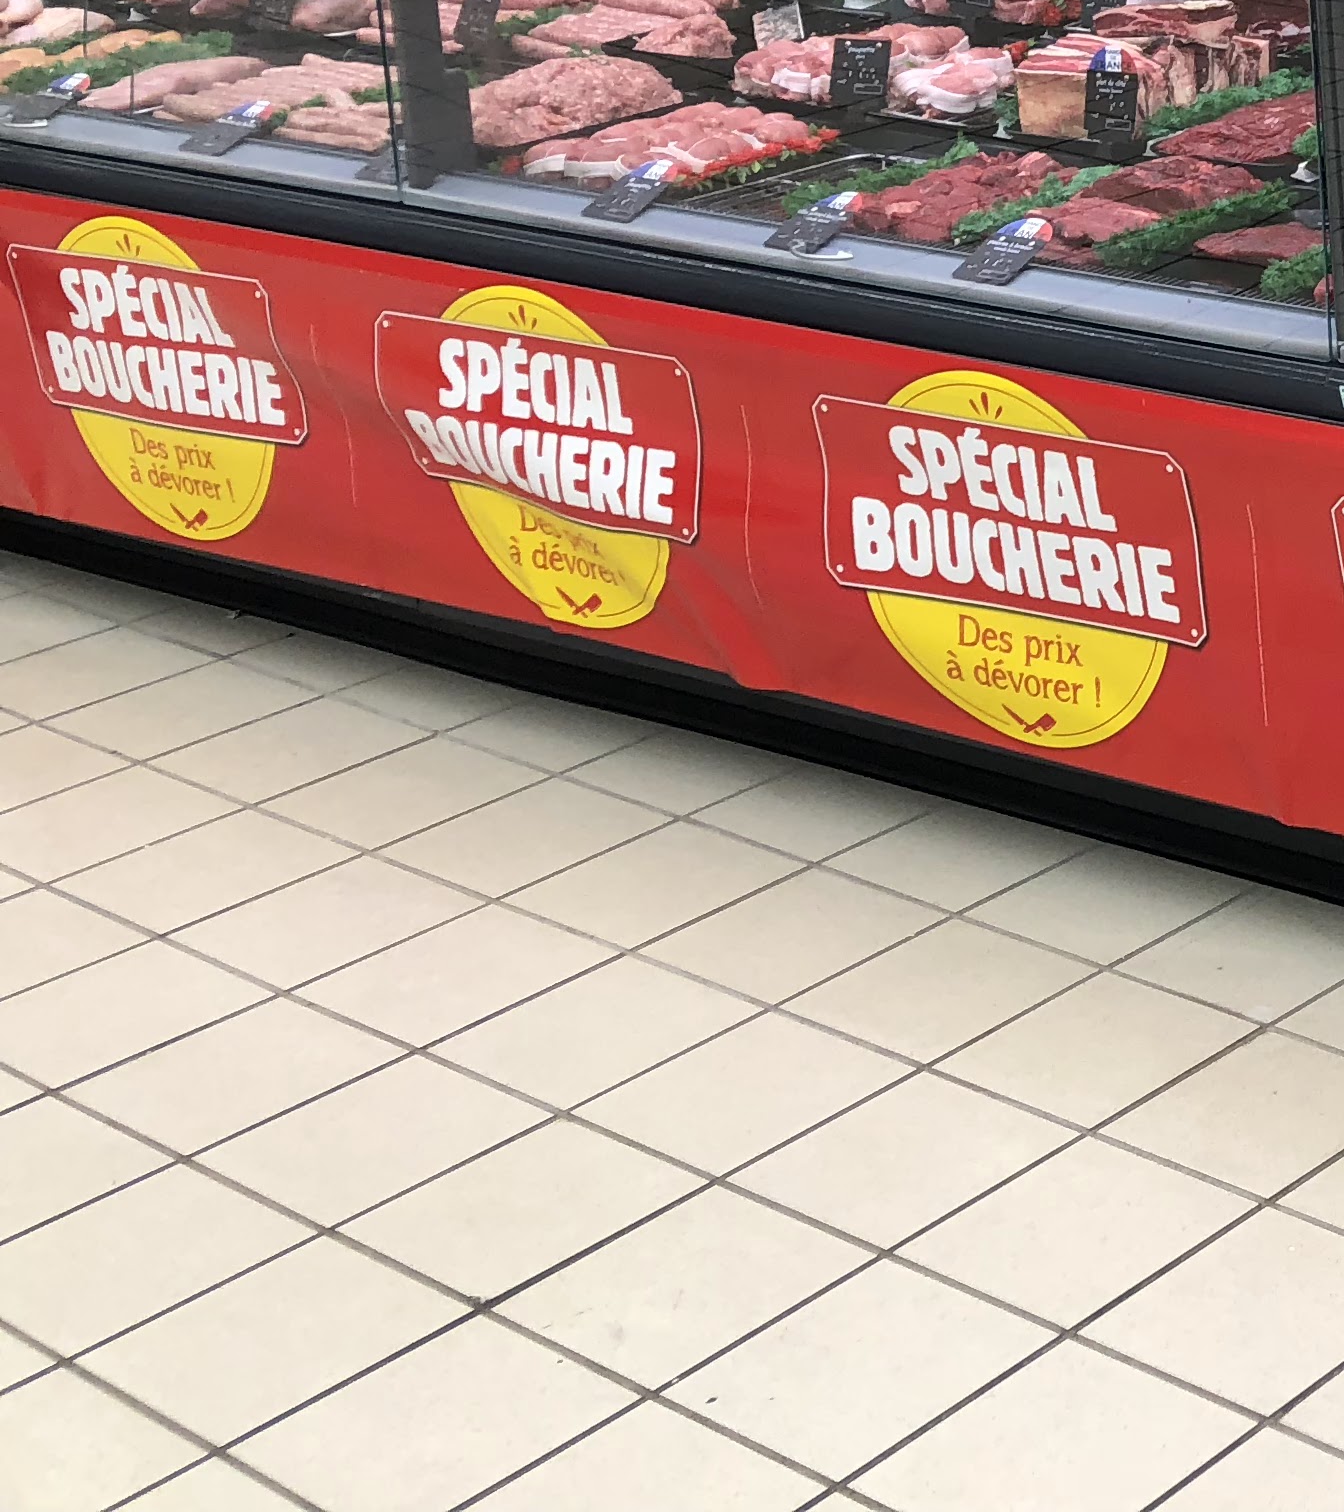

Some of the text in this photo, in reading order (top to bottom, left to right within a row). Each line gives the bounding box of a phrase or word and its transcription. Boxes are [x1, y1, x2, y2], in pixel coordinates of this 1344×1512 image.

[59, 265, 235, 348] SPÉCIAL
[46, 330, 286, 426] BOUCHERIE
[439, 338, 633, 434] SPÉCIAL
[130, 428, 215, 470] Des prix
[131, 458, 143, 484] à
[148, 464, 223, 498] dévorer
[404, 409, 676, 524] BOUCHERIE
[889, 426, 1117, 532] SPÉCIAL
[510, 537, 523, 566] à
[851, 496, 1180, 623] BOUCHERIE
[947, 650, 963, 681] à
[973, 658, 1083, 705] dévorer
[958, 614, 1083, 667] Des prix
